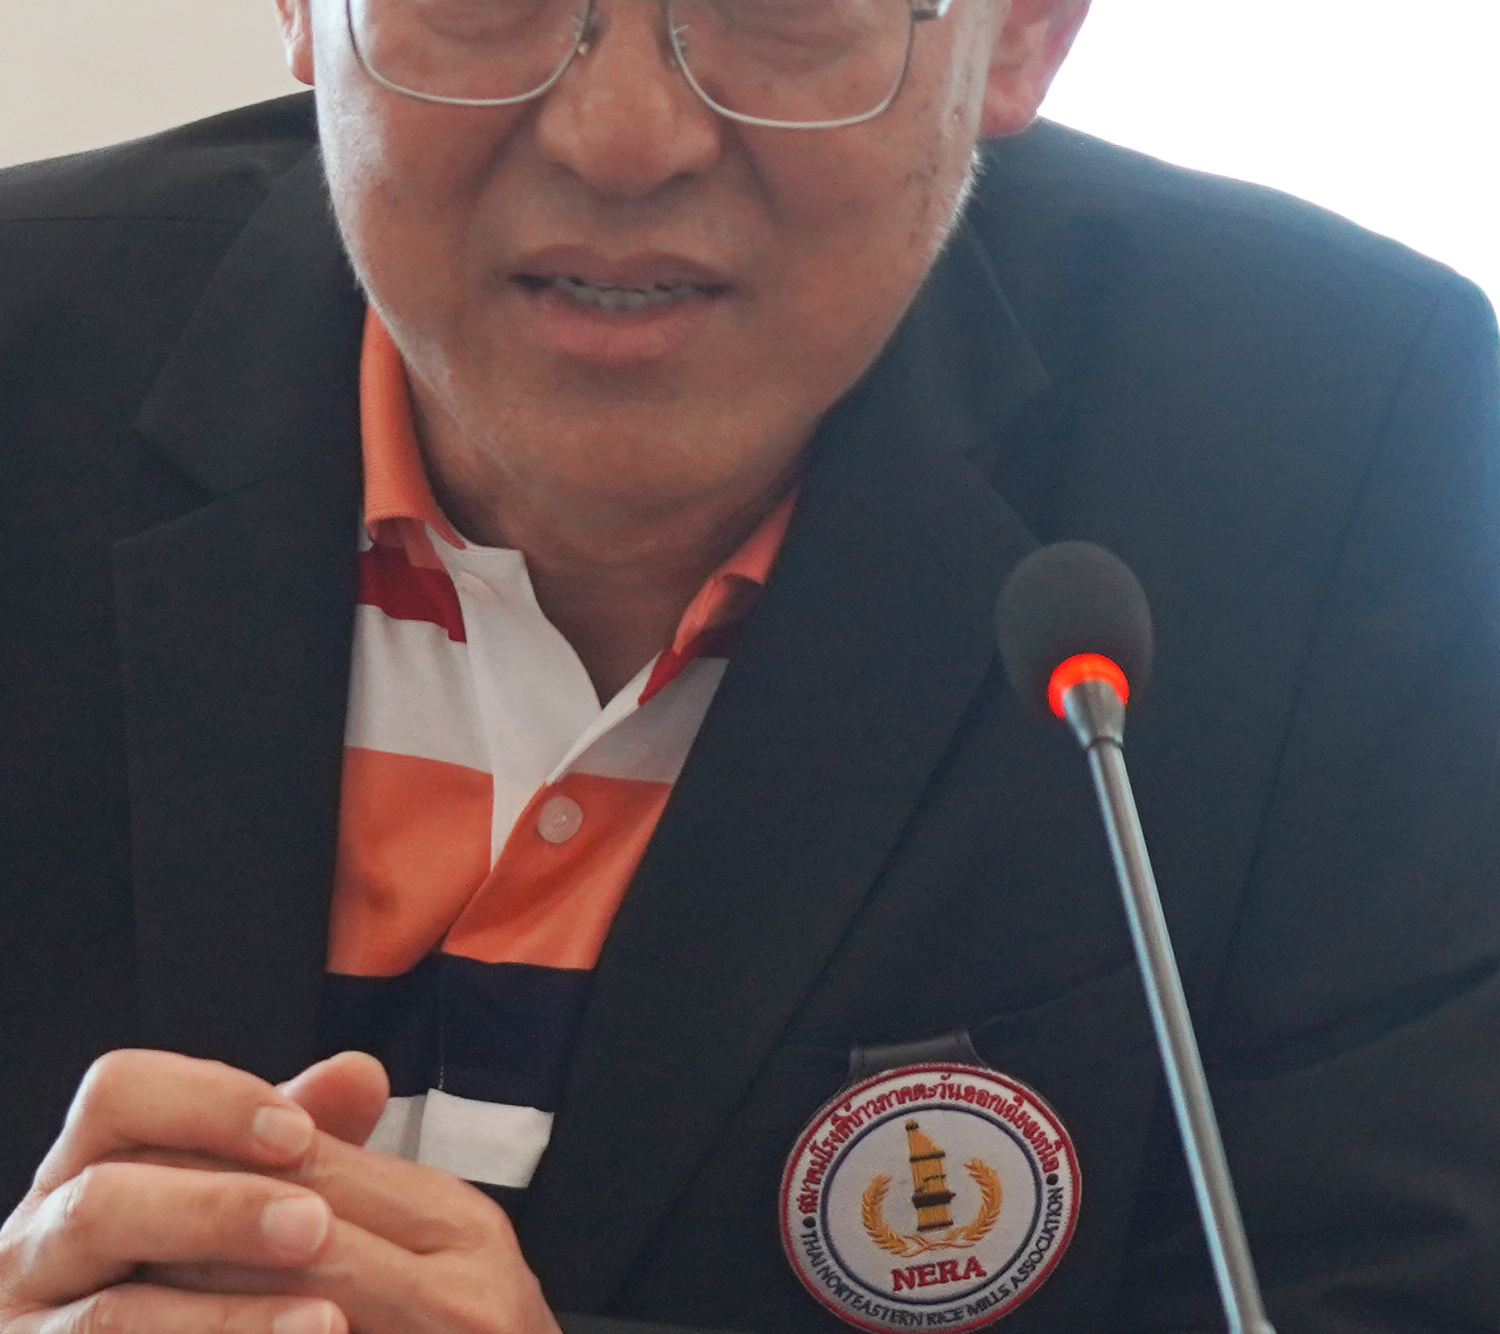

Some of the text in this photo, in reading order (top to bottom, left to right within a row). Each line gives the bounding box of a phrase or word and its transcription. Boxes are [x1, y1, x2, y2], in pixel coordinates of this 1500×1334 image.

[800, 1229, 827, 1268] THAI
[926, 1307, 964, 1327] RICE
[965, 1283, 1011, 1318] MILLS
[1010, 1185, 1065, 1290] ASSOCIATION
[891, 1255, 988, 1292] NERA
